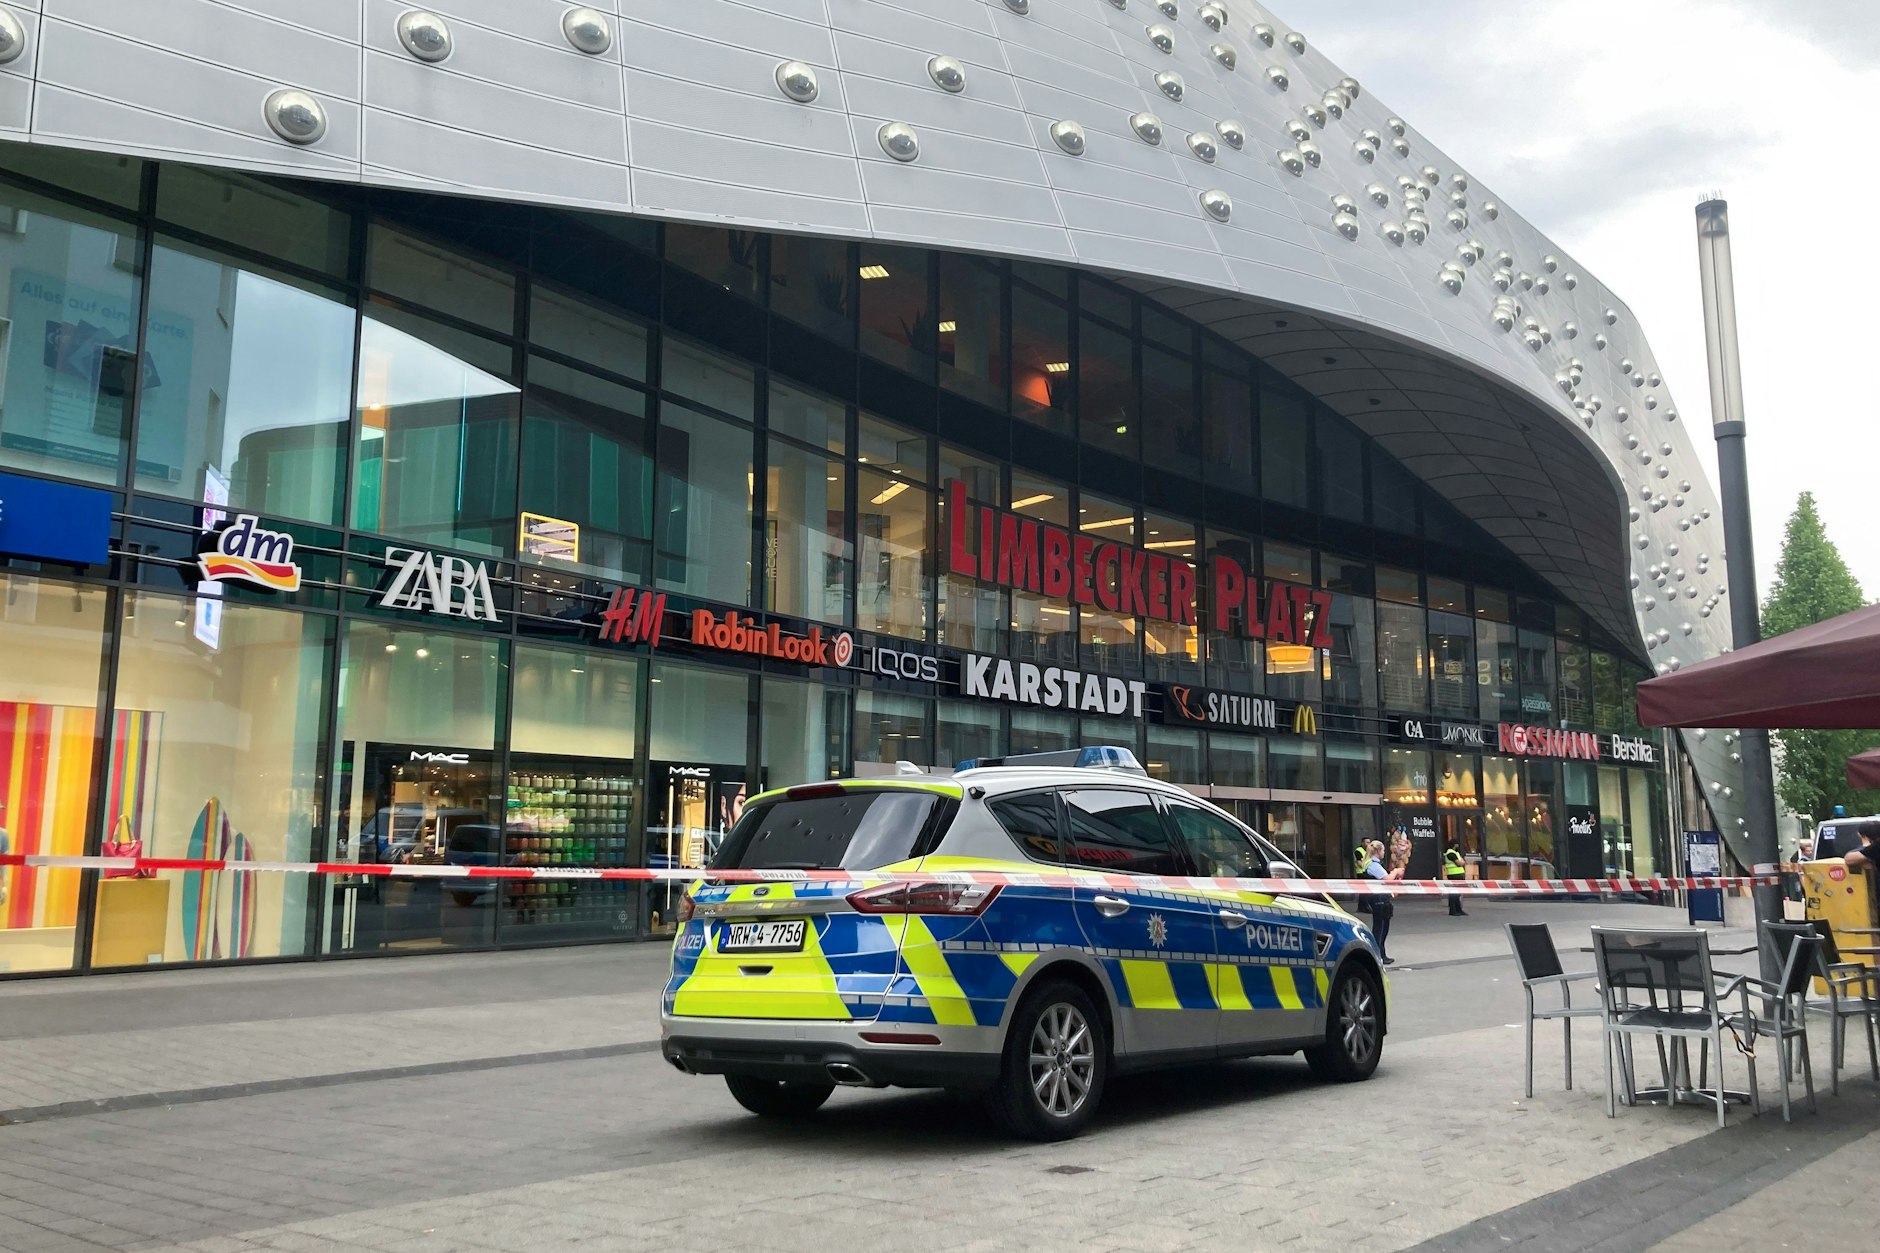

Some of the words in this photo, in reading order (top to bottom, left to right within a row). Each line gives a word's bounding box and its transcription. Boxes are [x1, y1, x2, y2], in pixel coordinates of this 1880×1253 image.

[223, 519, 290, 564] dm
[380, 546, 503, 623] ZARA
[1210, 552, 1335, 649] PLATZ
[600, 586, 666, 648] H&M
[872, 647, 939, 682] IQOS
[964, 653, 1146, 718] KARSTADT
[1207, 692, 1275, 729] SATURN
[1405, 720, 1424, 738] C&A
[1498, 722, 1599, 760] ROSSMANN
[410, 751, 469, 764] MAC
[1612, 733, 1653, 763] Bershka
[669, 766, 711, 777] MAC
[1412, 829, 1435, 837] Waffeln
[1413, 817, 1433, 826] Bubble
[1245, 924, 1304, 951] POLIZEI
